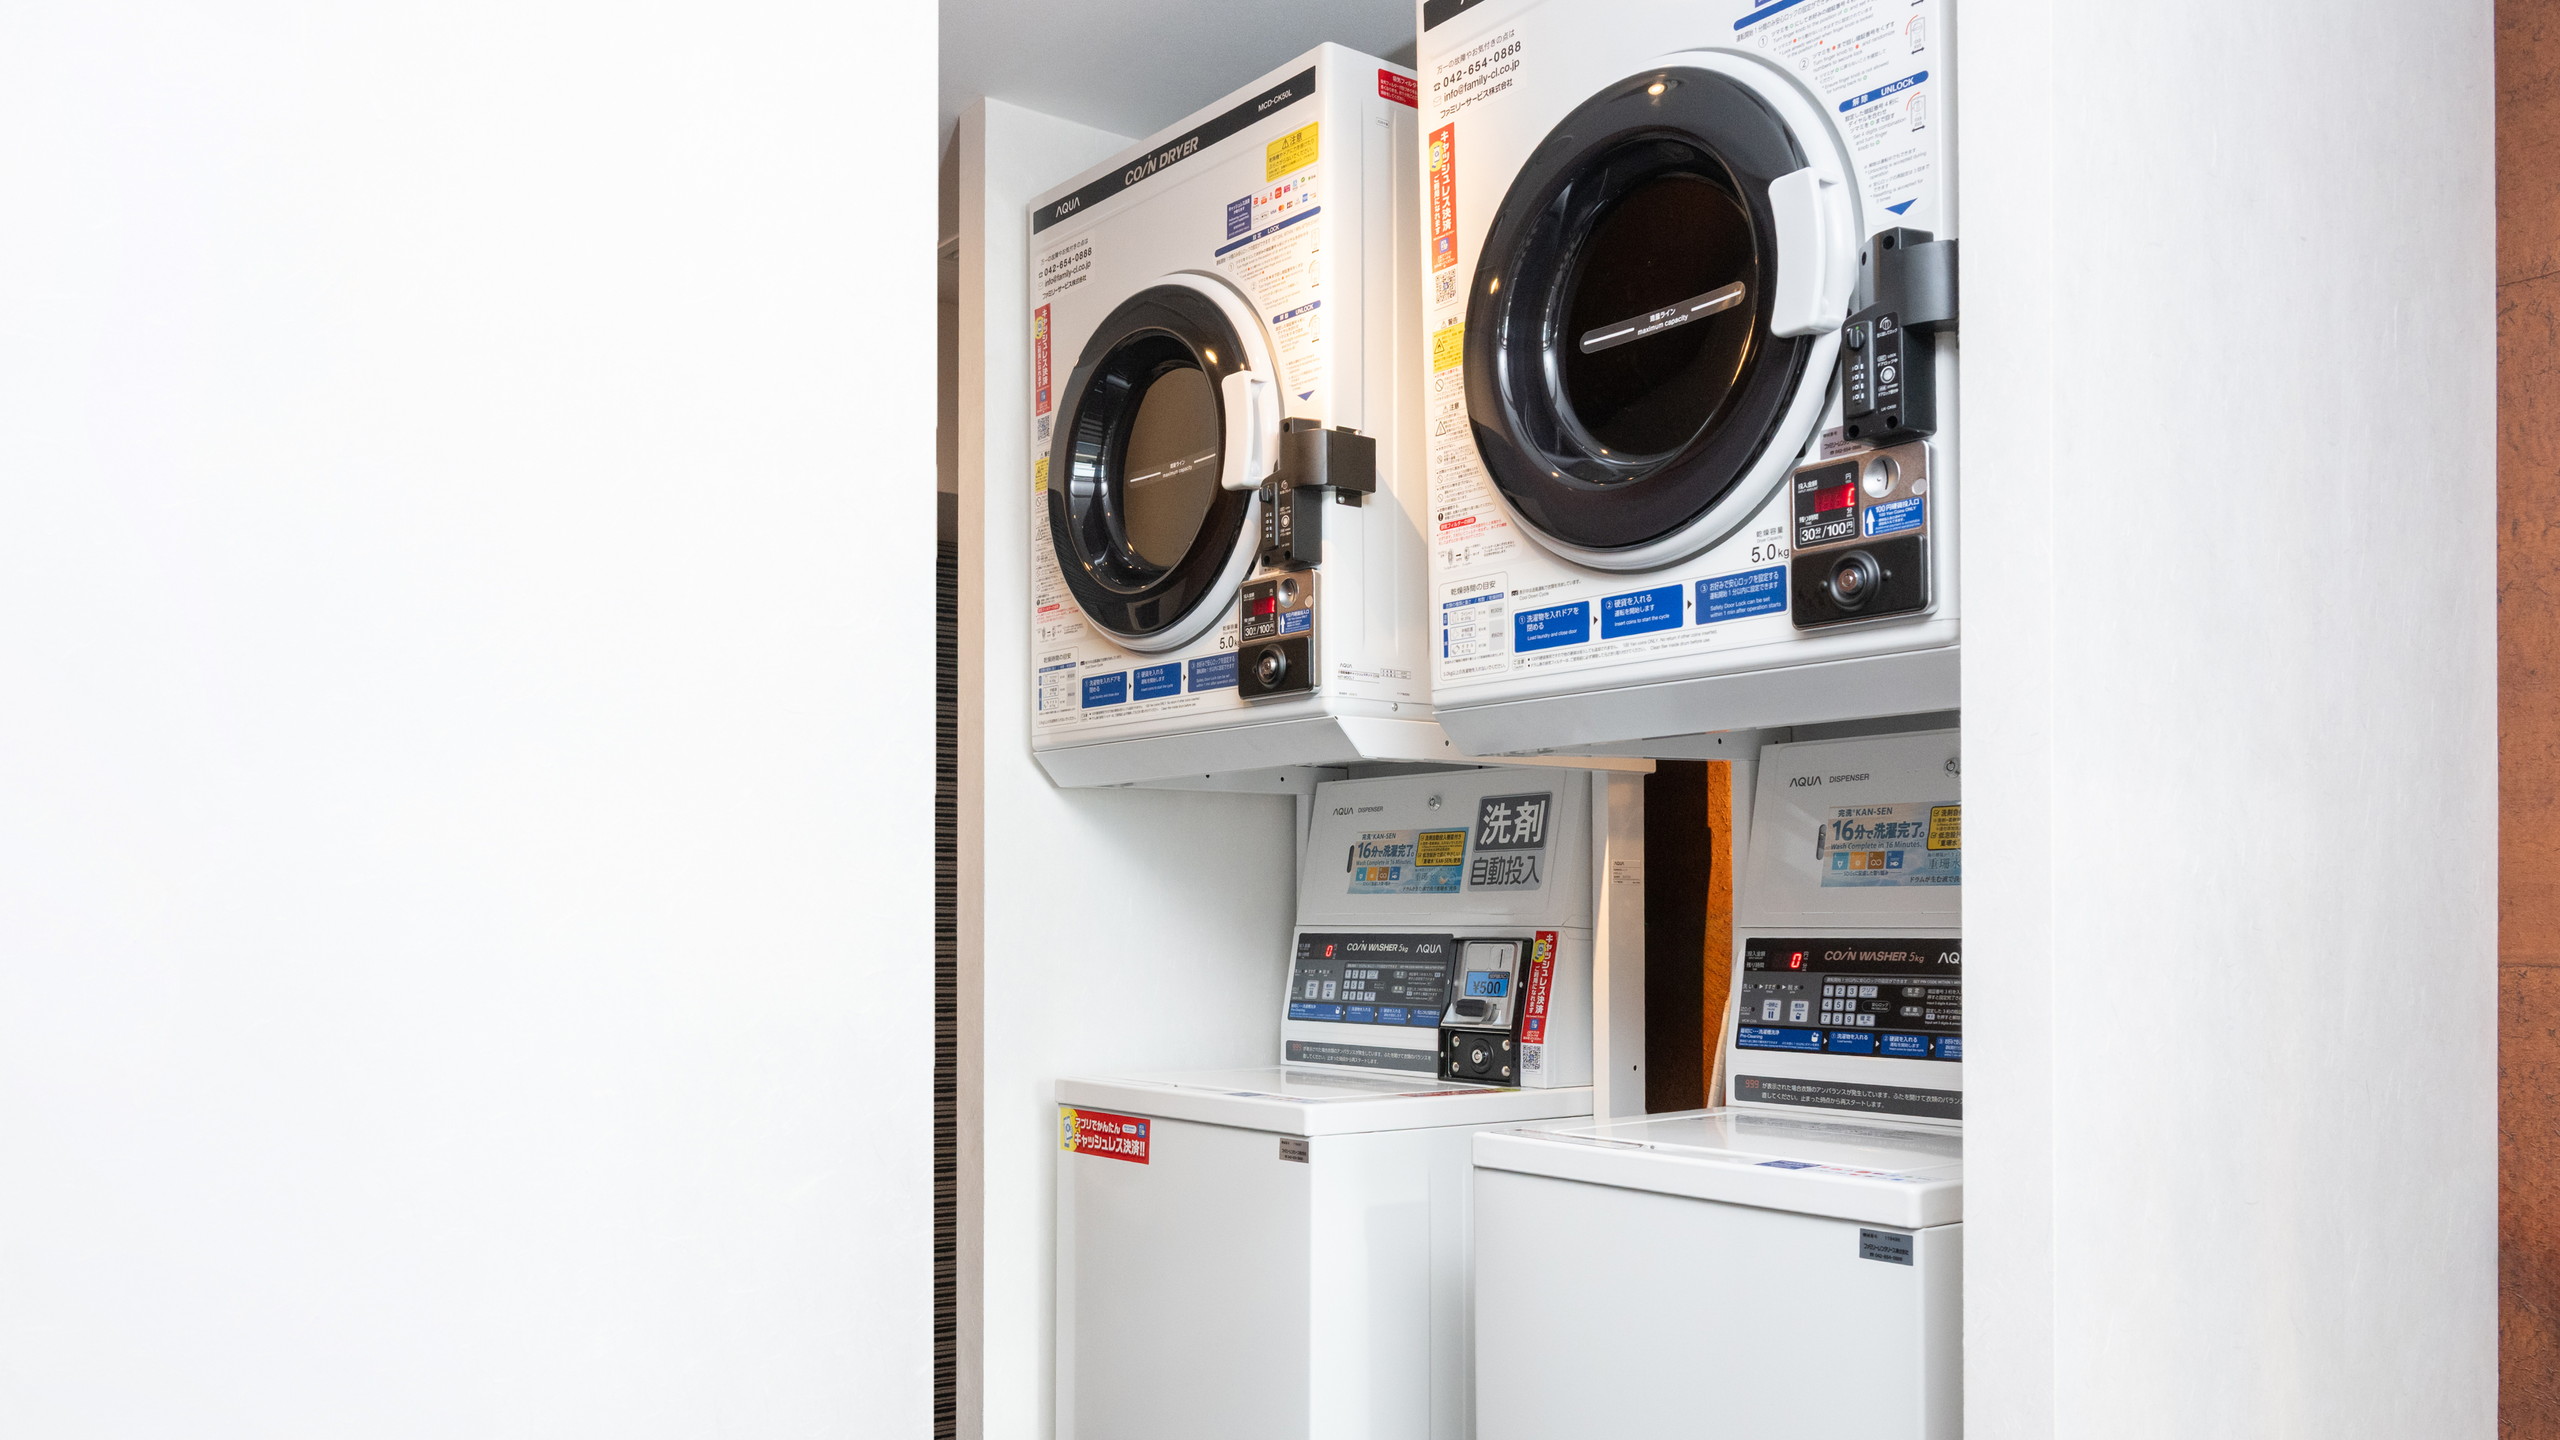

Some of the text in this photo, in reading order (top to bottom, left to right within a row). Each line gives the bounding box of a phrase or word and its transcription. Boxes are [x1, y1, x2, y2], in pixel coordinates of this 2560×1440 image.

[1443, 41, 1521, 87] 042-654-0888
[1444, 59, 1520, 102] info@family-cl.co.jp
[1880, 77, 1914, 96] UNLOCK
[1440, 78, 1513, 119] ファミリーサービス株式会社
[1158, 136, 1199, 170] DRYER
[1440, 131, 1452, 233] キャッシュレス決済
[1056, 197, 1081, 218] AQUA
[1267, 225, 1280, 234] LOCK
[1044, 247, 1092, 277] 042-654-0888
[1295, 303, 1314, 316] UNLOCK
[1637, 314, 1689, 336] maximum capacity
[1756, 526, 1783, 538] 乾燥容量
[1451, 580, 1496, 595] 乾燥時間の目安
[1709, 571, 1779, 592] お好みで安心ロックを設定する
[1614, 593, 1653, 608] 硬貨を入れる
[1746, 604, 1768, 613] operation
[1526, 607, 1579, 623] 洗濯物を入れドアを
[1614, 604, 1655, 617] 運転を開始します
[1658, 613, 1670, 621] cycle
[1526, 622, 1544, 632] 閉める
[1789, 773, 1870, 787] AQUA DISPENSER
[1333, 806, 1384, 816] AQUA DISPENSER
[1480, 800, 1546, 845] 洗剤
[1832, 819, 1925, 841] 16分で洗濯完了。
[1357, 841, 1414, 859] 16分で洗濯完了。
[1847, 840, 1879, 850] Complete
[1878, 840, 1885, 848] in
[1894, 840, 1923, 848] Minutes.
[1470, 855, 1540, 886] 自動投入
[1325, 944, 1334, 957] 0
[1368, 942, 1398, 952] WASHER
[1398, 943, 1409, 953] 5kg
[1416, 944, 1442, 953] AQUA
[1790, 952, 1802, 968] 0
[1859, 951, 1907, 961] WASHER
[1908, 952, 1925, 963] 5kg
[1535, 933, 1553, 1015] キャッシュレス決済
[1473, 981, 1501, 994] ¥500
[1528, 966, 1541, 1014] ご利用になれます
[1075, 1117, 1121, 1134] アプリでかんたん
[1074, 1132, 1146, 1157] キャッシュレス決済!!
